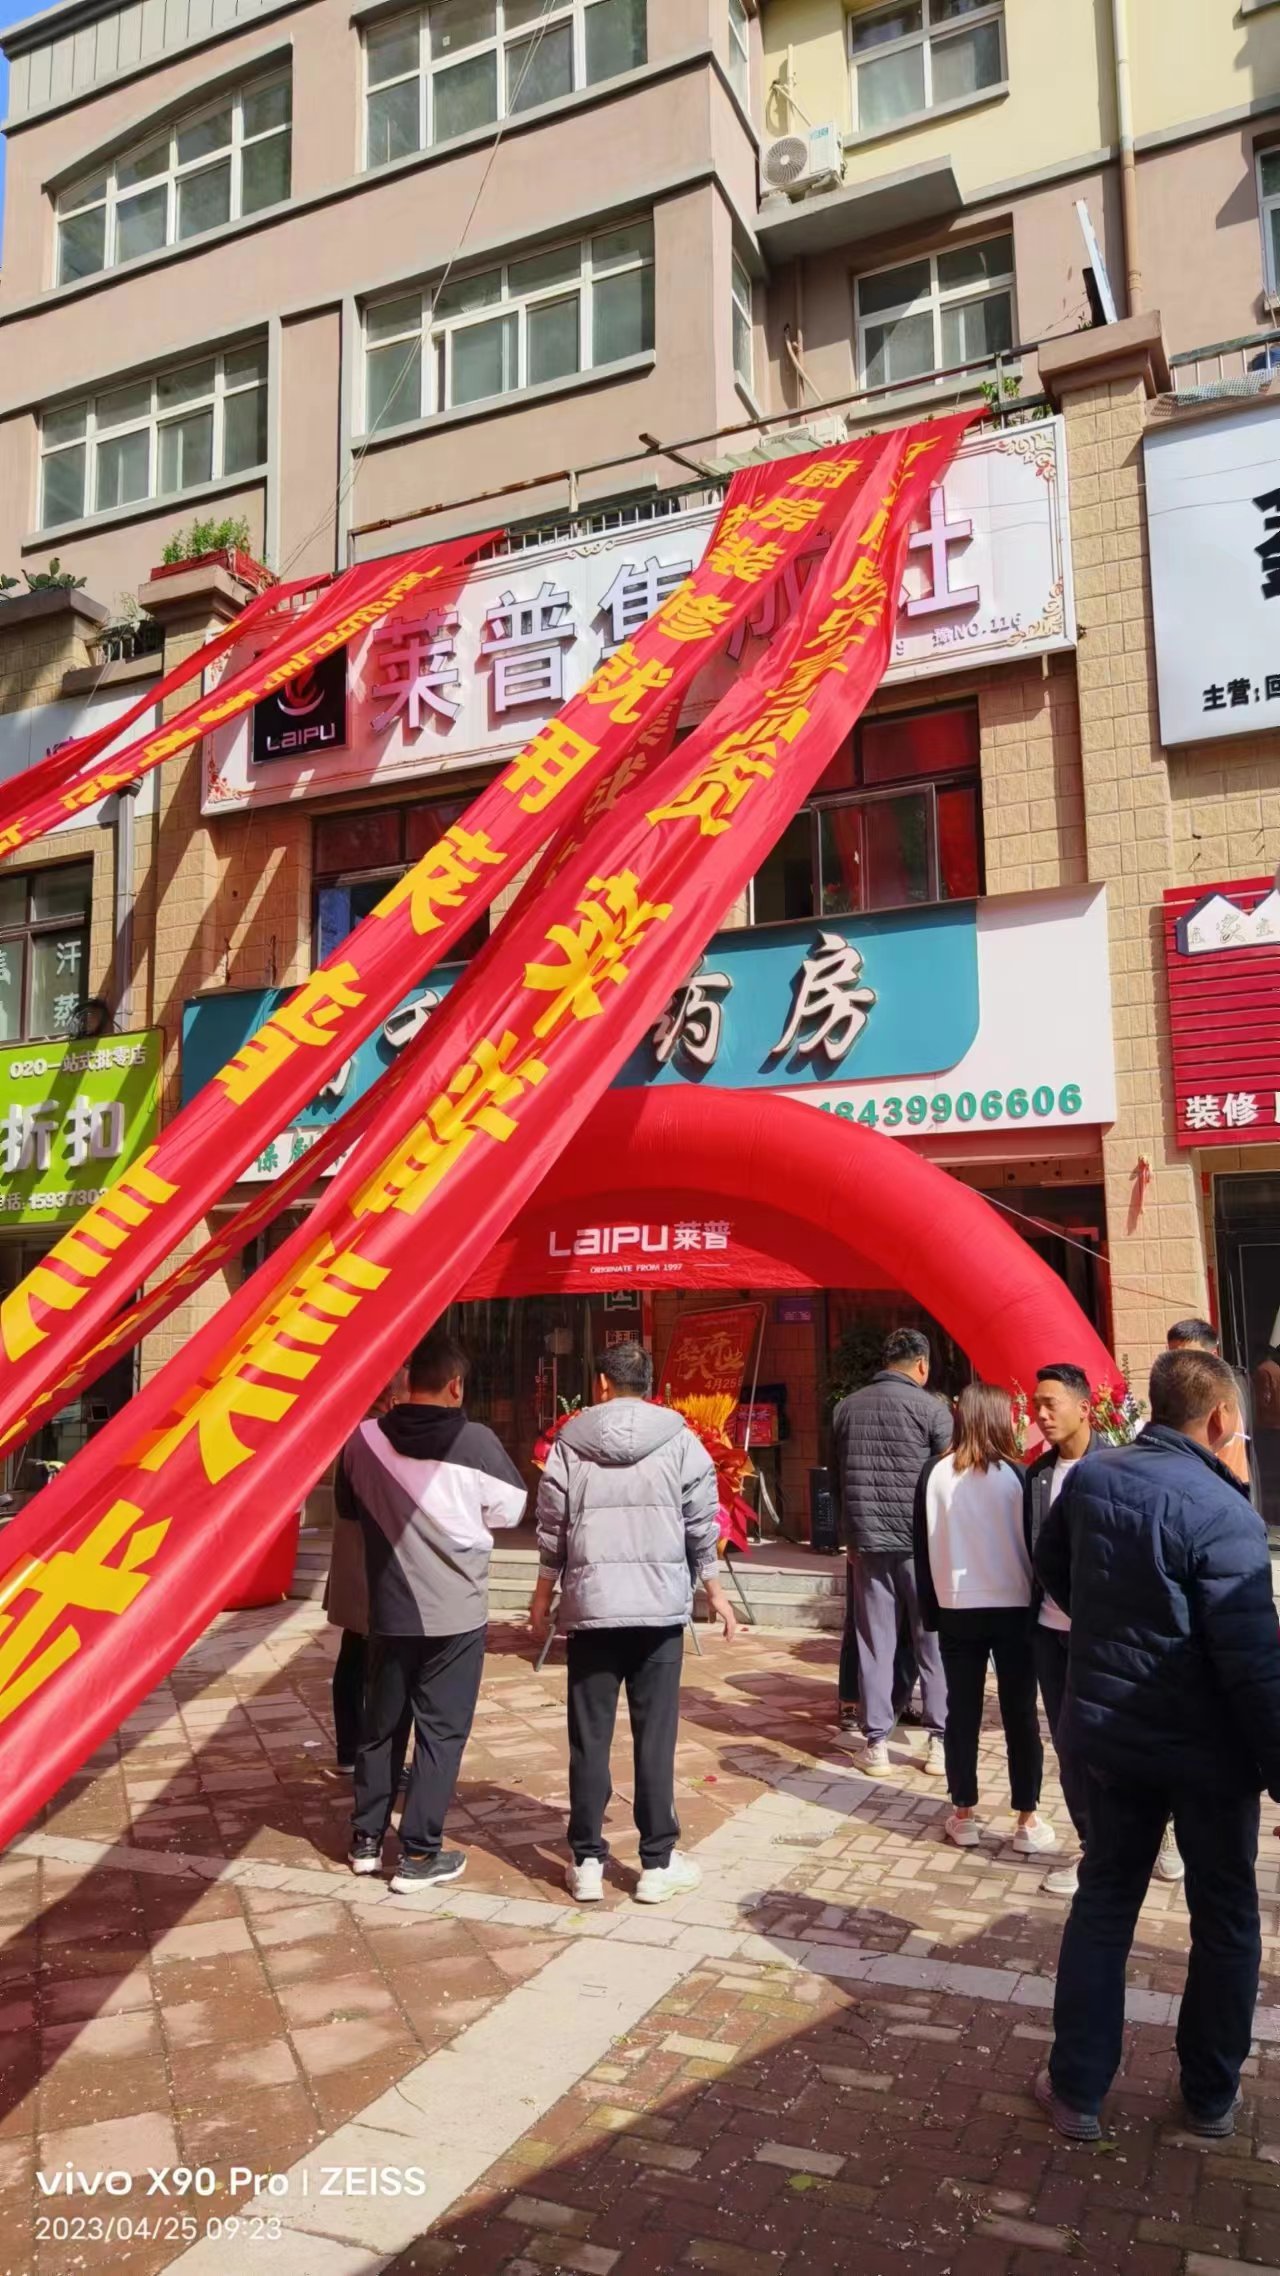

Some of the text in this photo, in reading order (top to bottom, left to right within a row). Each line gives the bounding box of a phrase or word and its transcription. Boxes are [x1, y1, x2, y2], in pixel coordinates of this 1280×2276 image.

[54, 940, 82, 1028] 汗蒸
[1185, 1091, 1258, 1129] 装修
[673, 1221, 732, 1250] 莱普
[636, 1263, 660, 1272] FROM
[663, 1263, 683, 1271] 1997
